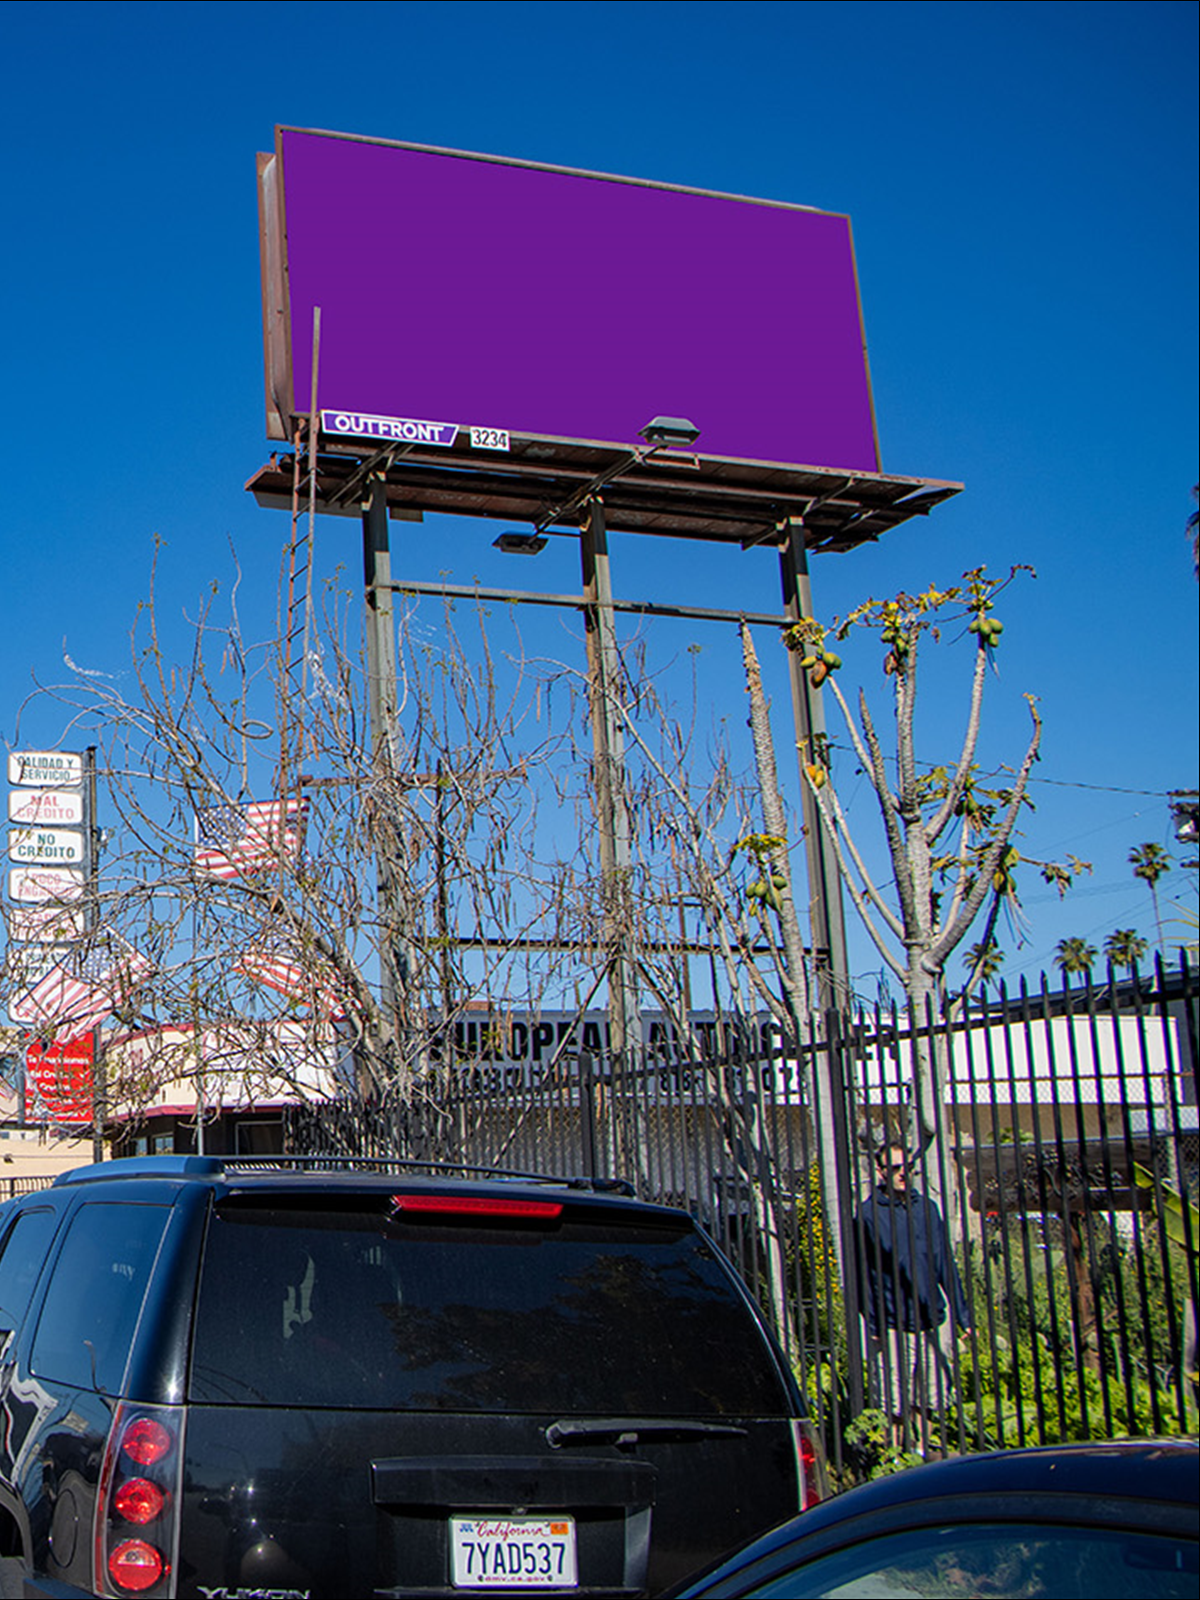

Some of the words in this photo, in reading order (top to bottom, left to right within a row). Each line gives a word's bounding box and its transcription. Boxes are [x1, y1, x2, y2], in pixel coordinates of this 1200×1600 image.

[334, 413, 445, 442] OUTFRONT
[472, 428, 508, 449] 3234
[17, 755, 64, 769] CALIDAD
[65, 758, 74, 769] Y
[22, 768, 71, 782] SERVICIO
[31, 795, 60, 807] MAL
[17, 807, 75, 820] CREDITO
[37, 833, 56, 846] NO
[17, 845, 76, 859] CREDITO
[477, 1521, 550, 1541] California
[461, 1541, 566, 1575] 7YAD537
[196, 1585, 311, 1599] YUKON
